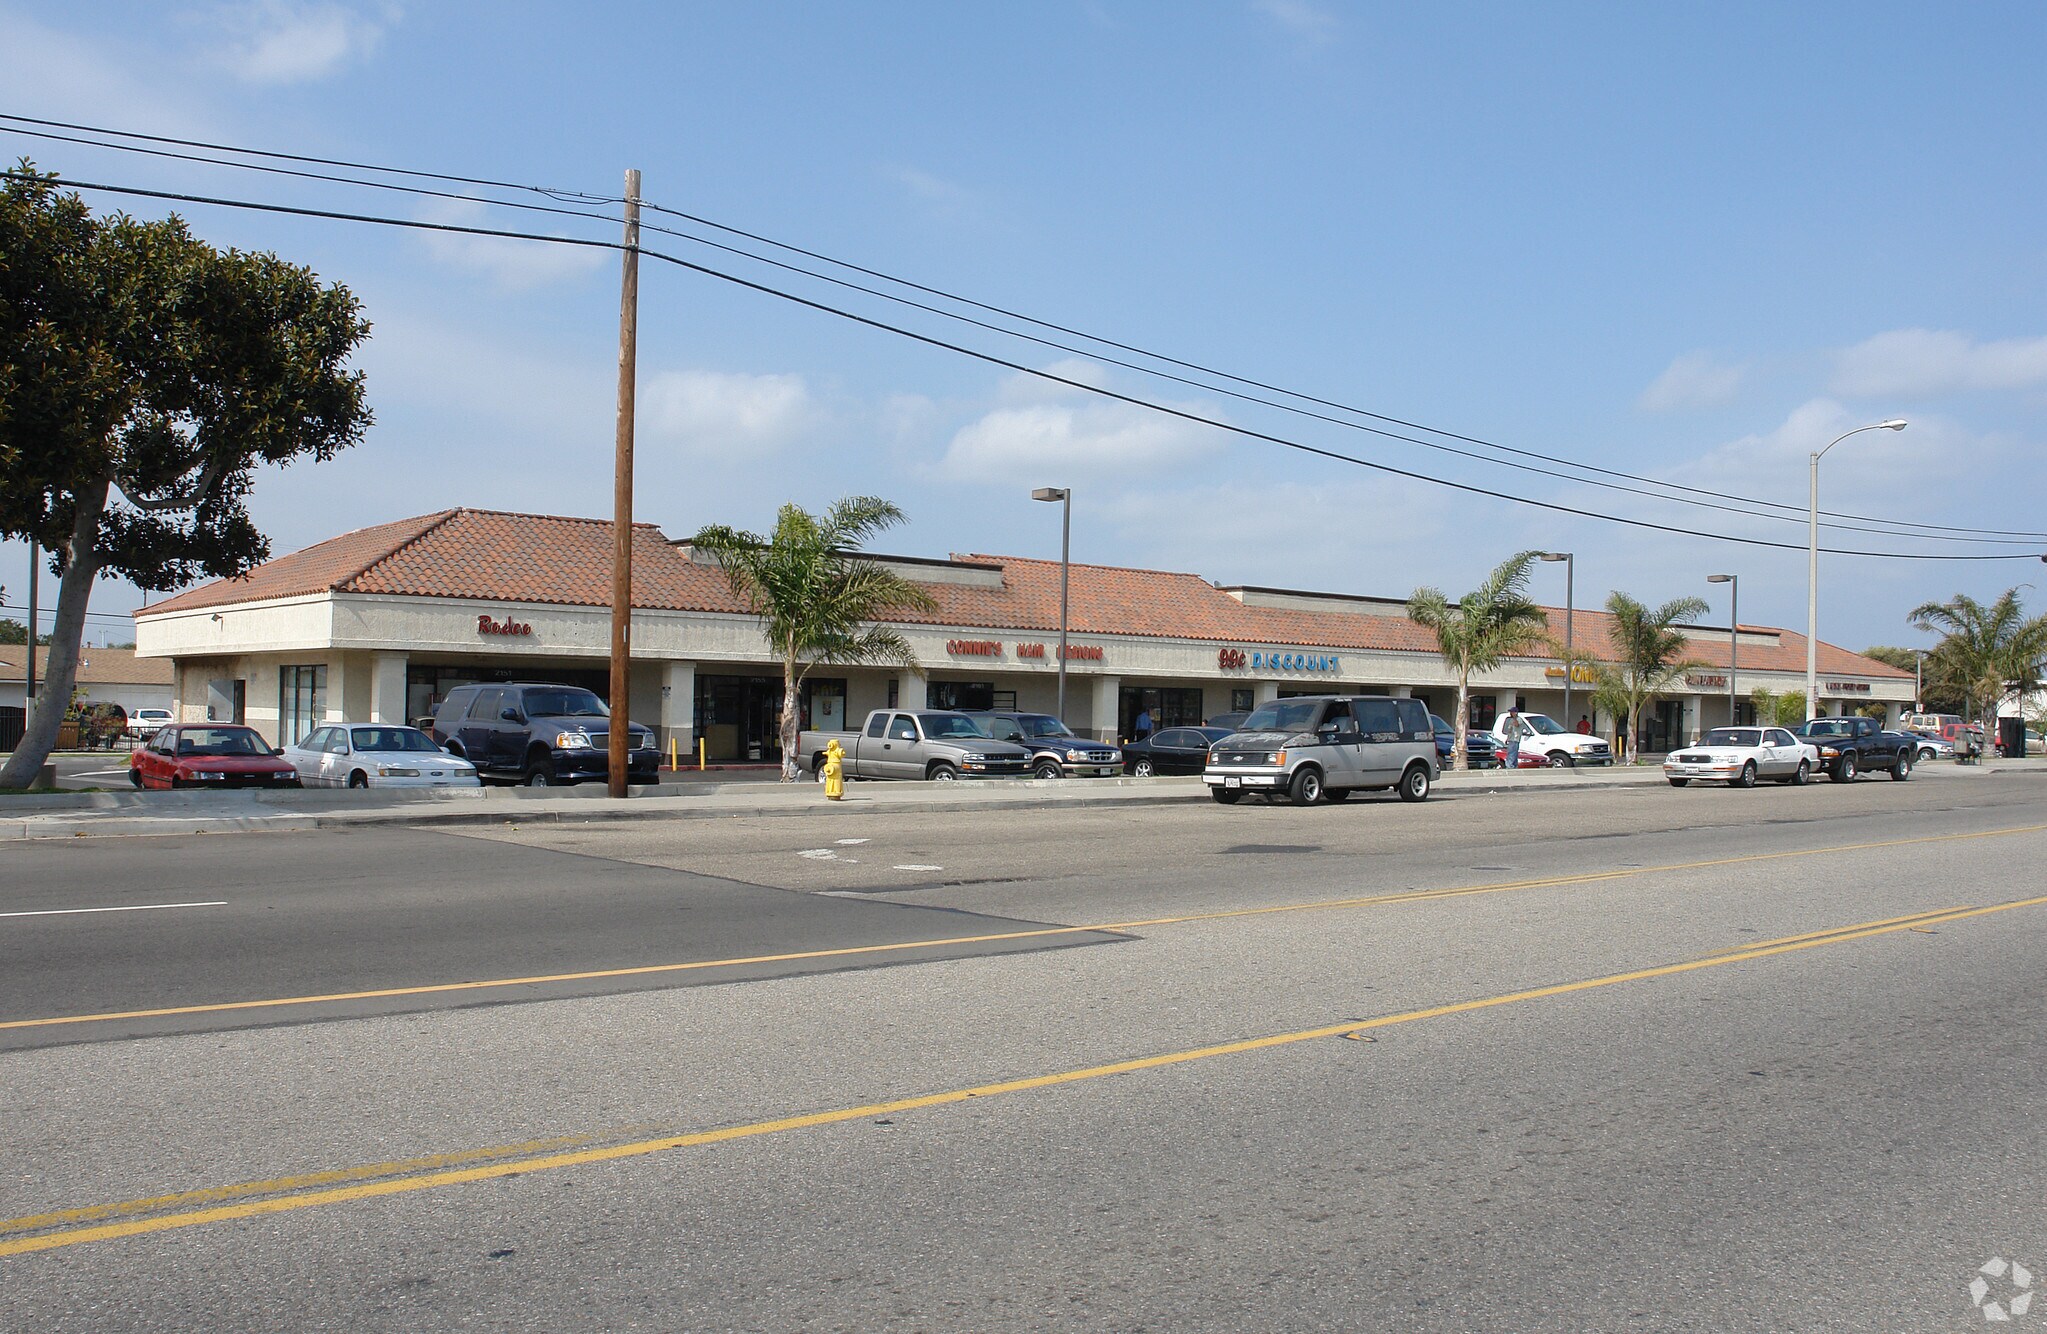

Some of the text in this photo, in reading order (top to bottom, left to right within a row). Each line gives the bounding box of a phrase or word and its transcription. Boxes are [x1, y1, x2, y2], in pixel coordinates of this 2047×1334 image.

[478, 615, 532, 635] Rodeo
[947, 639, 1003, 657] CONNIE'S
[1017, 643, 1045, 659] HAIR
[1252, 652, 1339, 672] DISCOUNT
